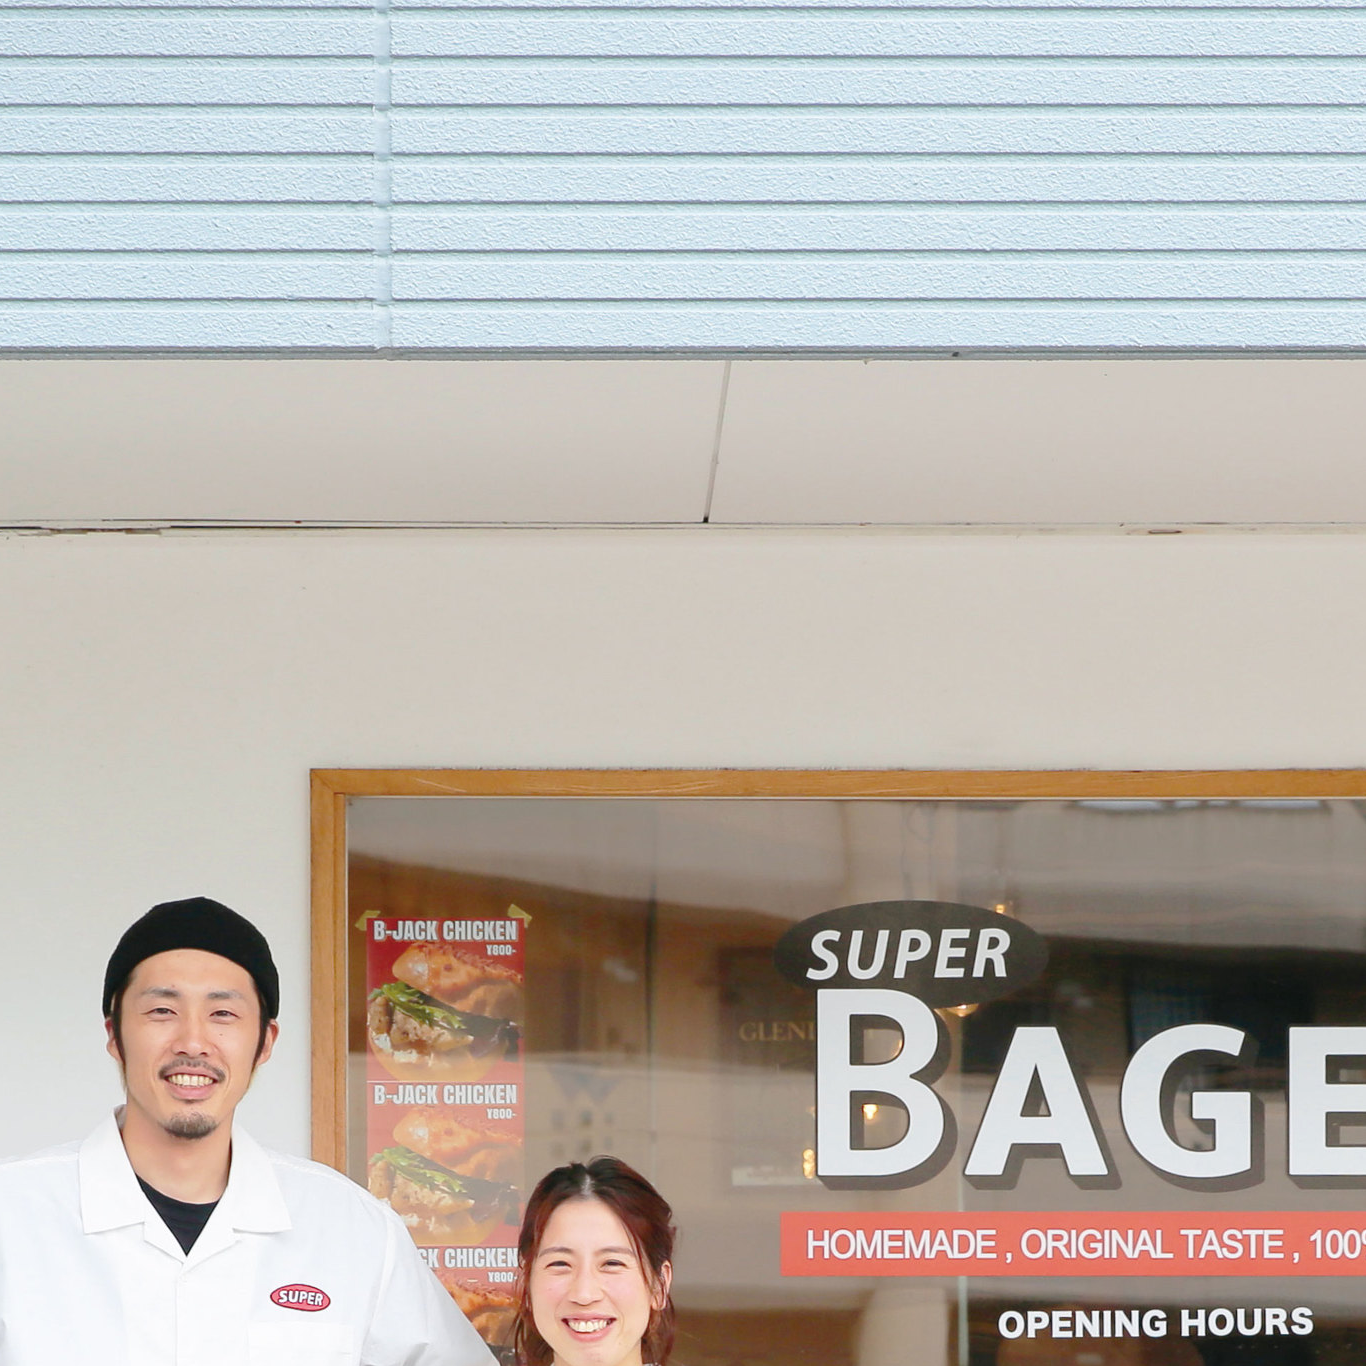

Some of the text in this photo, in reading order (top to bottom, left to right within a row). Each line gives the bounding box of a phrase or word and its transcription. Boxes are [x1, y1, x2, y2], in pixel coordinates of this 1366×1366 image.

[374, 920, 518, 941] B-JACK CHICKEN
[806, 928, 1011, 981] SUPER
[374, 1084, 518, 1105] B-JACK CHICKEN
[807, 1229, 997, 1259] HOMEMADE
[1020, 1229, 1174, 1259] ORIGINAL
[1180, 1229, 1284, 1259] TASTE
[443, 1248, 519, 1268] CHICKEN
[278, 1289, 324, 1306] SUPER
[998, 1307, 1314, 1339] OPENING HOURS
